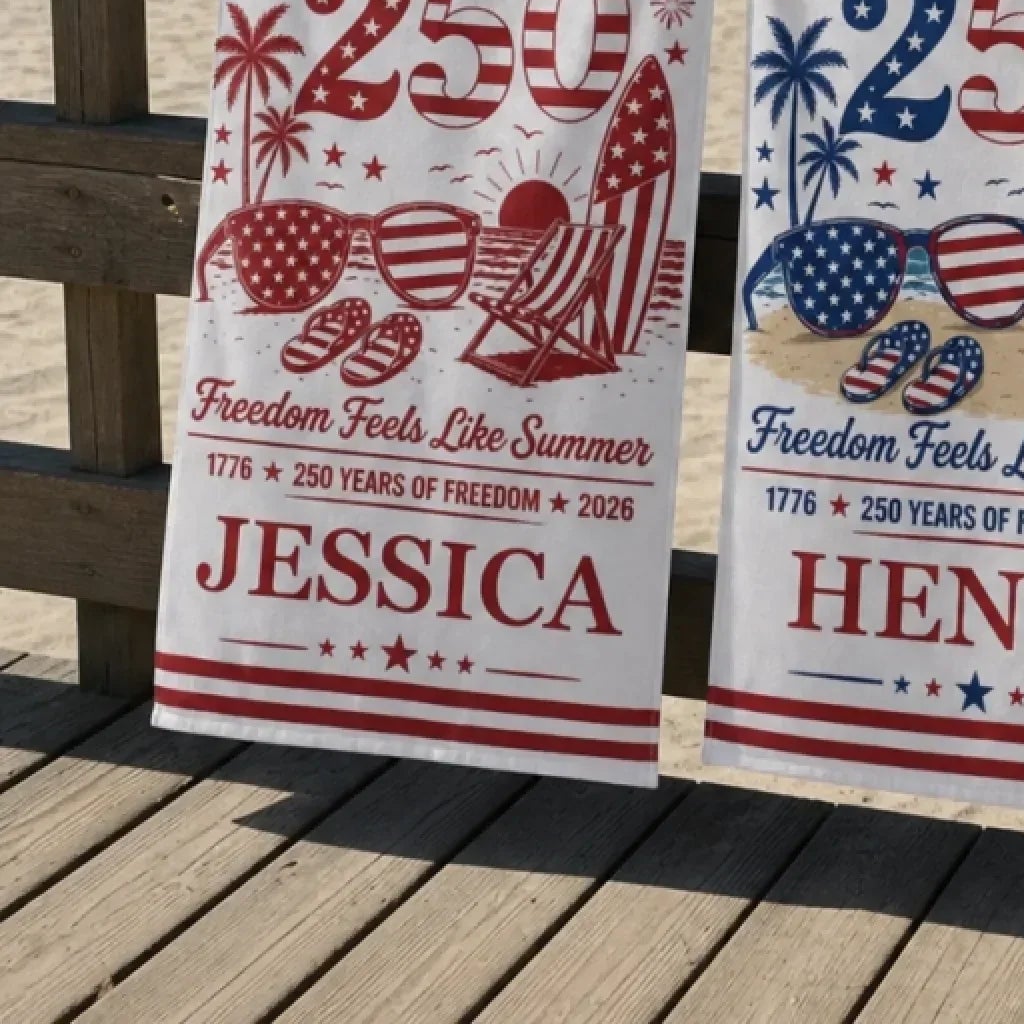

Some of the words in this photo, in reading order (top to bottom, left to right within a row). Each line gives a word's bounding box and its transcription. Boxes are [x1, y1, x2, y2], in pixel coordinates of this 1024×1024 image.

[191, 377, 334, 433] Freedom
[339, 396, 428, 444] Feels
[430, 407, 508, 453] Like
[511, 414, 655, 467] Summer
[746, 405, 900, 464] Freedom
[906, 421, 998, 472] Feels
[207, 452, 253, 481] 1776
[293, 462, 333, 489] 250
[340, 466, 405, 497] YEARS
[412, 472, 438, 500] OF
[444, 478, 541, 513] FREEDOM
[578, 494, 634, 521] 2026
[766, 486, 817, 515] 1776
[861, 496, 901, 523] 250
[908, 500, 976, 530] YEARS
[983, 506, 1010, 534] OF
[196, 515, 623, 636] JESSICA
